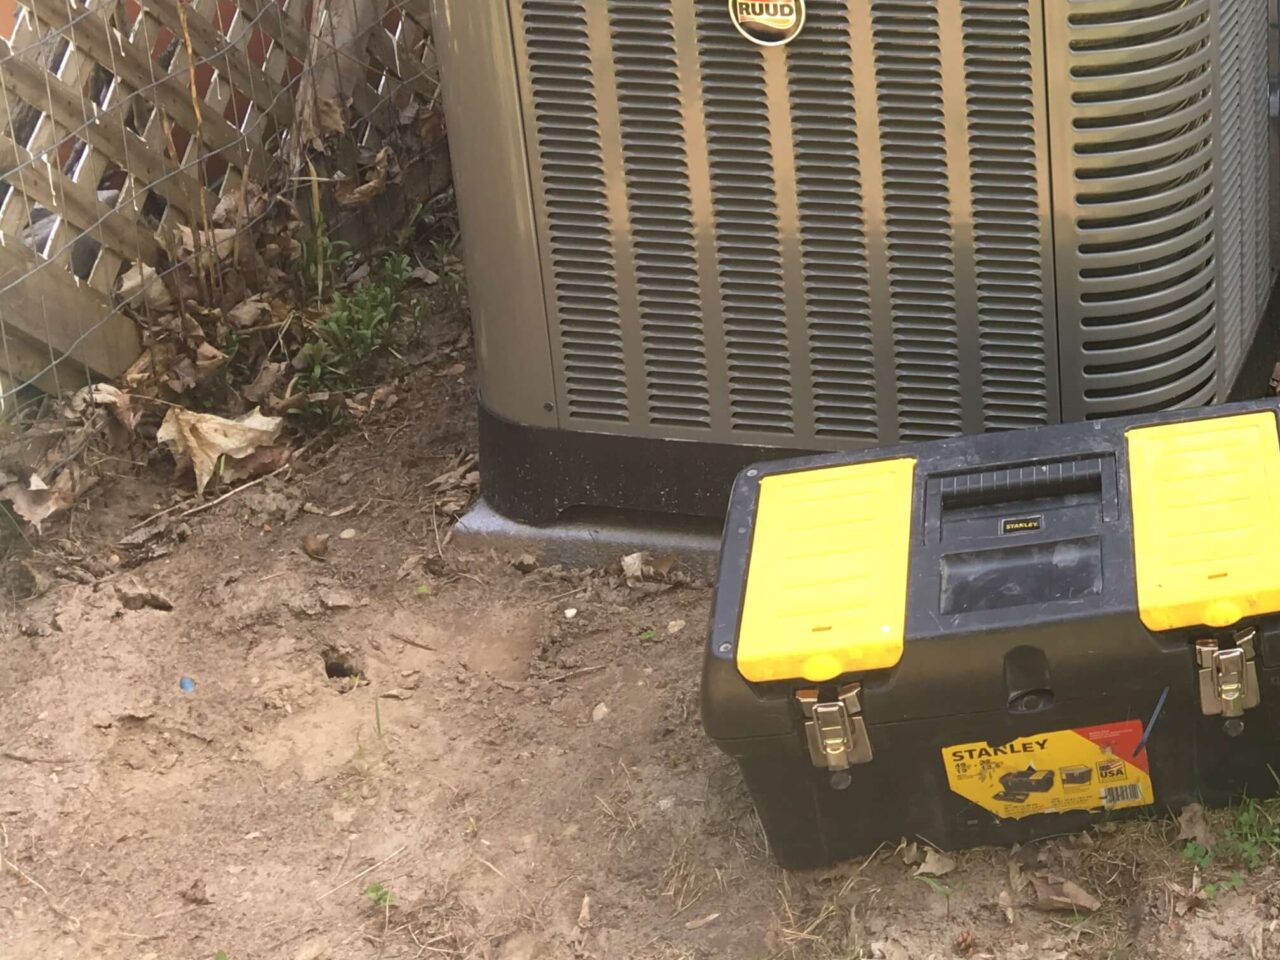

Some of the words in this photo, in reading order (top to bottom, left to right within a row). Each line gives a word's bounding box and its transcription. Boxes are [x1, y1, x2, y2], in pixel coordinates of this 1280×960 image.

[738, 2, 794, 17] RUUD
[1006, 521, 1038, 530] STANLEY
[952, 739, 1049, 762] STANLEY
[1100, 768, 1124, 779] USA
